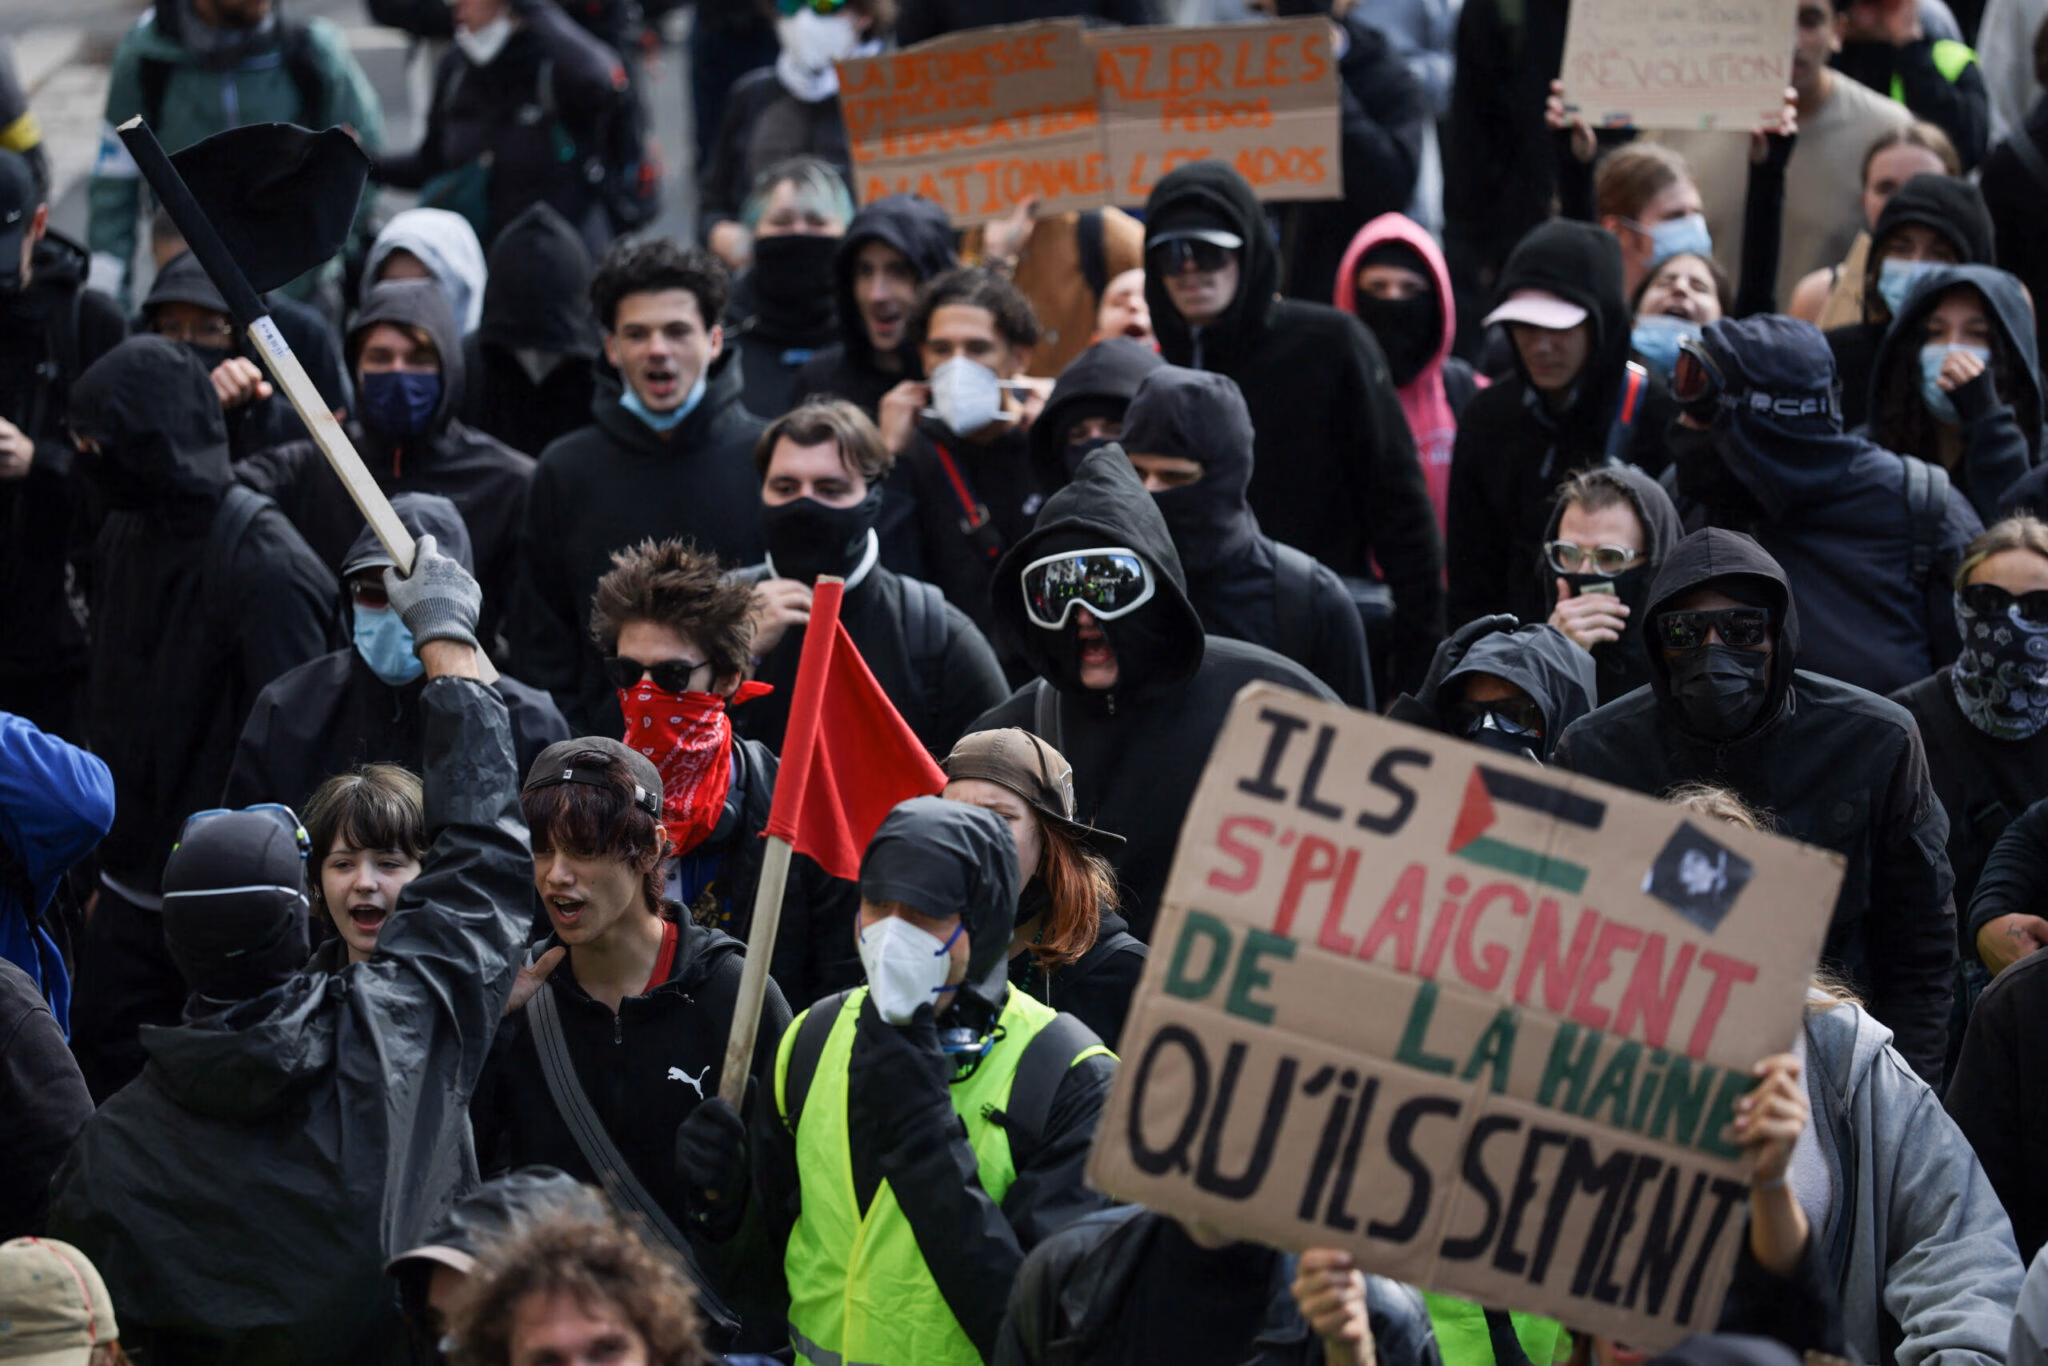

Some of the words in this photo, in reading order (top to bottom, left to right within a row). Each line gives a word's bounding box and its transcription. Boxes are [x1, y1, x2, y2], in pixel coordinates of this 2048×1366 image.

[839, 62, 887, 94] LA
[1233, 34, 1328, 88] LES
[1236, 706, 1433, 836] ILS
[1162, 908, 1297, 1026] DE
[1395, 983, 1521, 1095] LA
[1439, 1114, 1752, 1326] SEMENT
